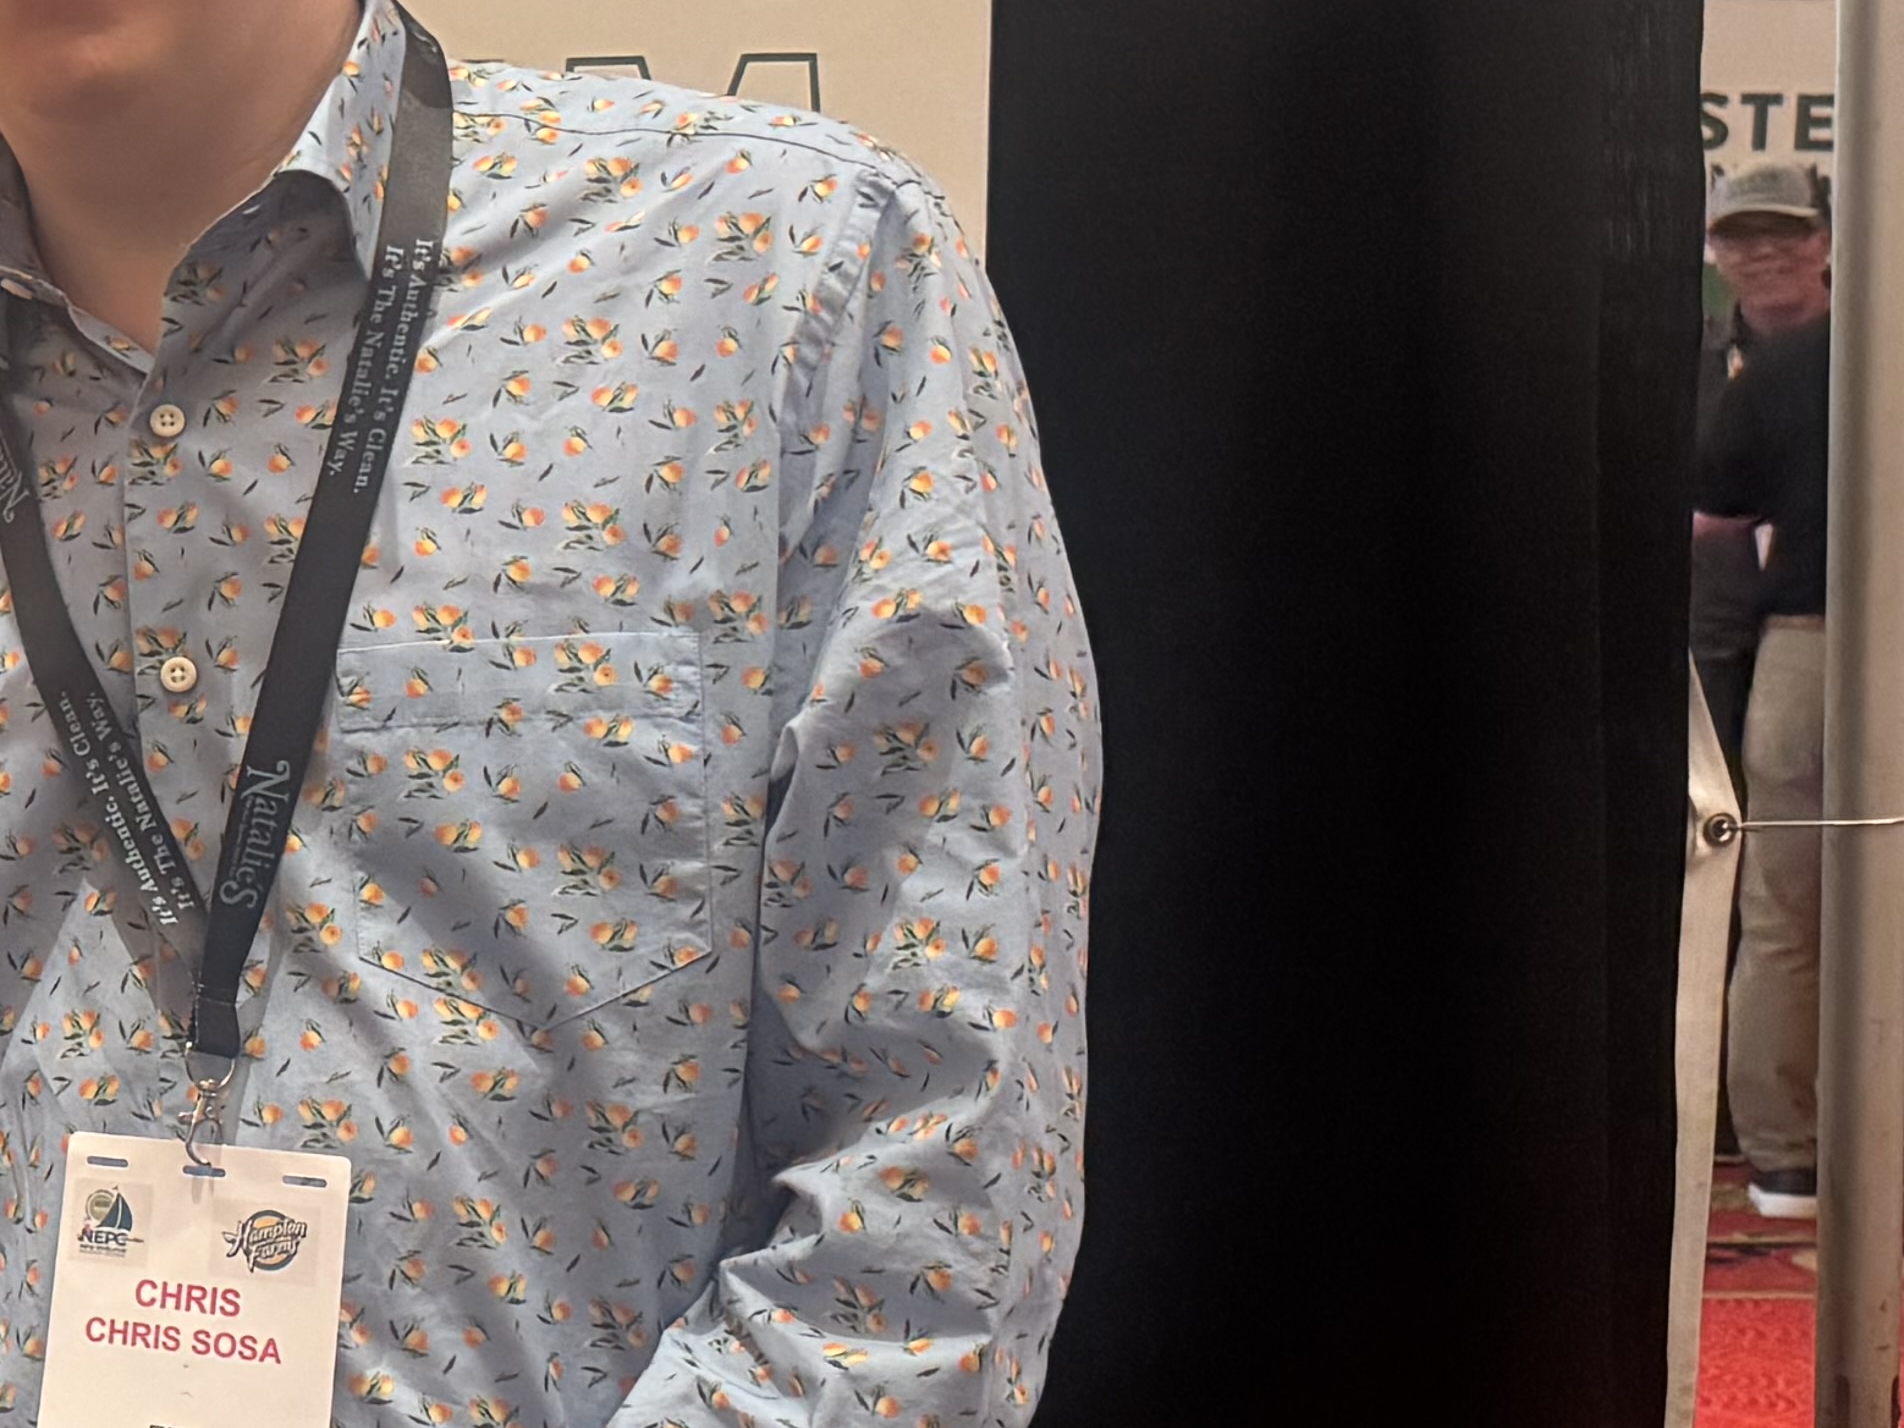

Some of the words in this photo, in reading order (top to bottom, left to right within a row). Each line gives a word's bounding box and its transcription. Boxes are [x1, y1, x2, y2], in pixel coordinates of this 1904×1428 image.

[380, 245, 405, 280] It's
[411, 238, 434, 273] It's
[369, 286, 397, 324] The
[384, 274, 427, 381] Authentic.
[344, 329, 386, 424] Natalie's
[373, 385, 399, 422] It's
[328, 430, 359, 477] Way.
[352, 428, 387, 494] Clean.
[59, 690, 91, 757] Clean.
[86, 691, 112, 741] Way.
[85, 758, 110, 795] It's
[108, 740, 158, 832] Natalie's
[104, 796, 159, 893] Authentic.
[150, 833, 176, 875] The
[136, 1278, 242, 1317] CHRIS
[85, 1316, 181, 1352] CHRIS
[192, 1330, 282, 1364] SOSA
